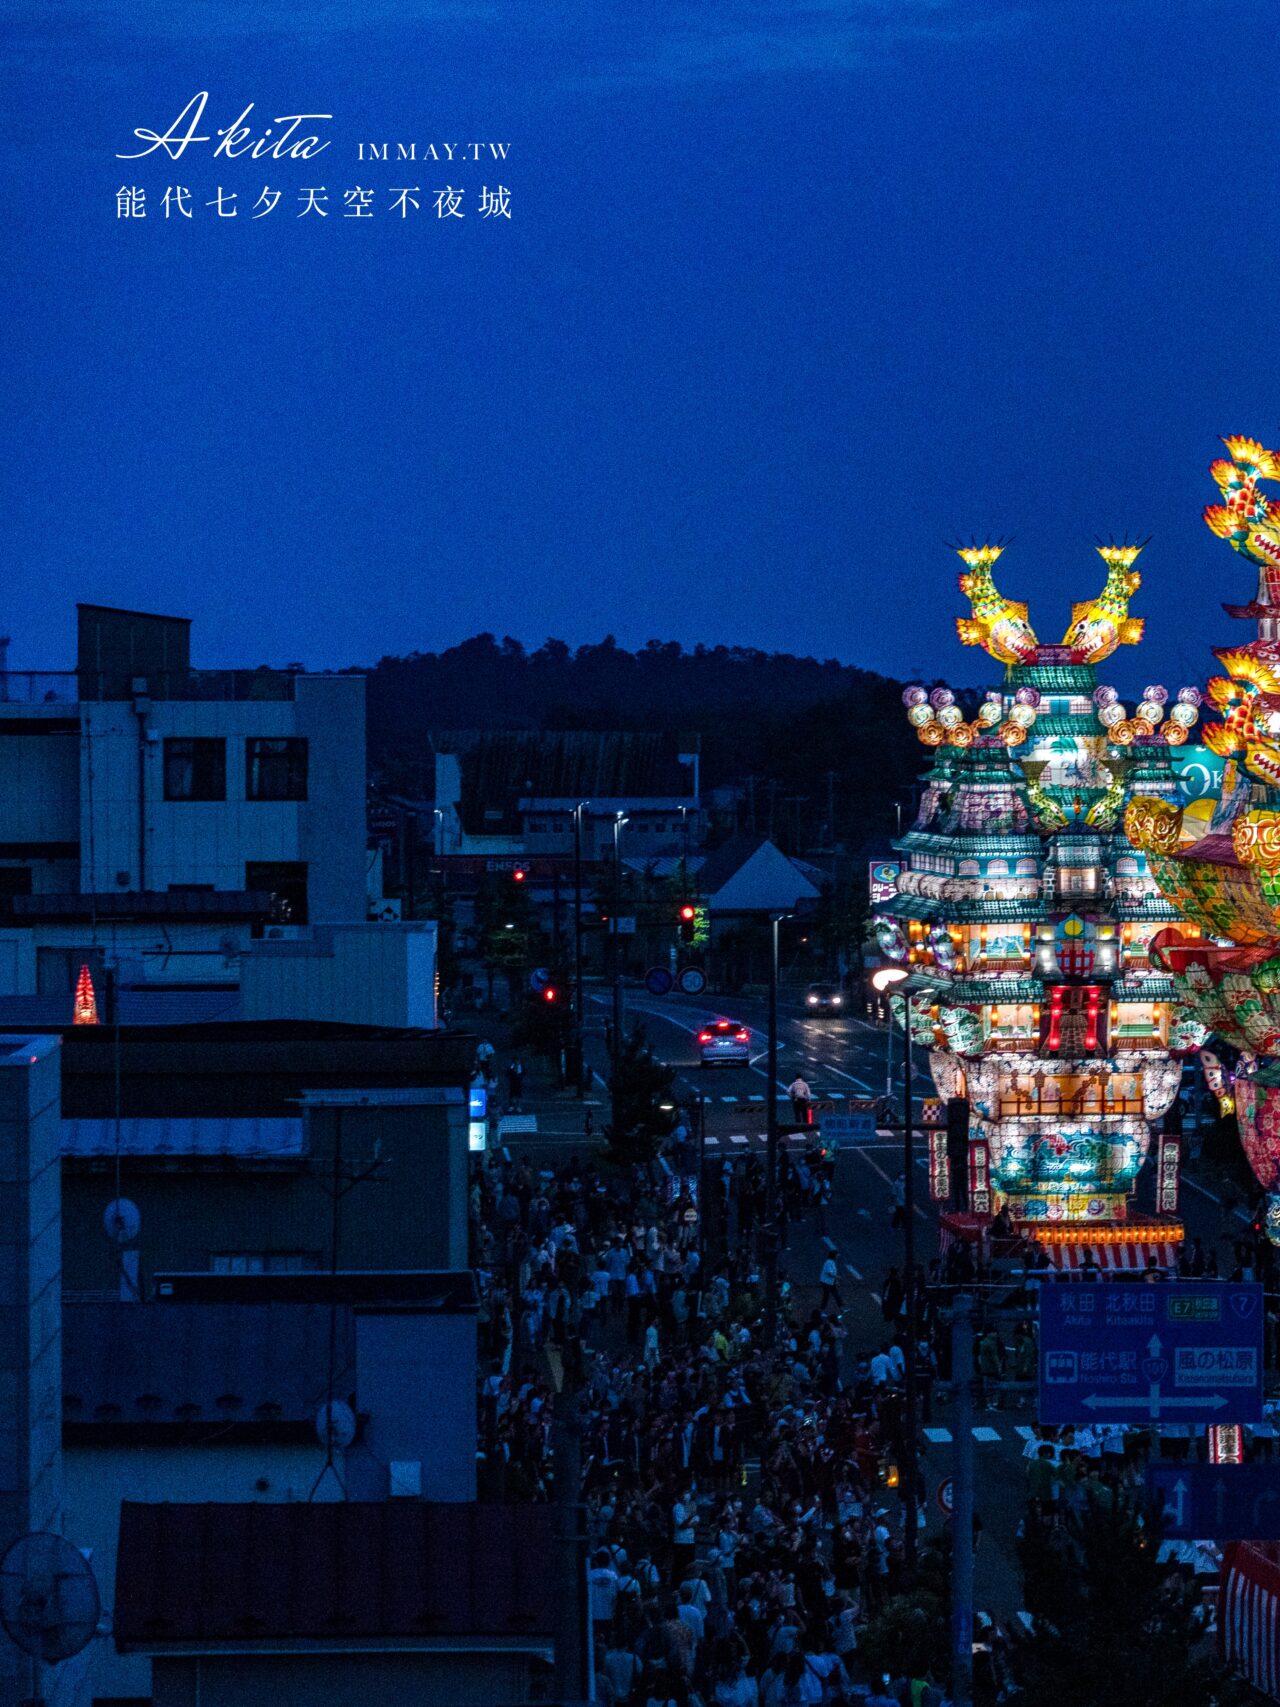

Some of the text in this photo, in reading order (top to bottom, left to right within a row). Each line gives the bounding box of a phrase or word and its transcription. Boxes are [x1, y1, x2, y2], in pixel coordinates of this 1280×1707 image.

[1060, 1293, 1155, 1312] 秋田 北秋田
[1174, 1302, 1190, 1313] E7
[1239, 1297, 1248, 1311] 7
[1081, 1351, 1137, 1370] 能代駅
[1178, 1350, 1253, 1370] 風の松原
